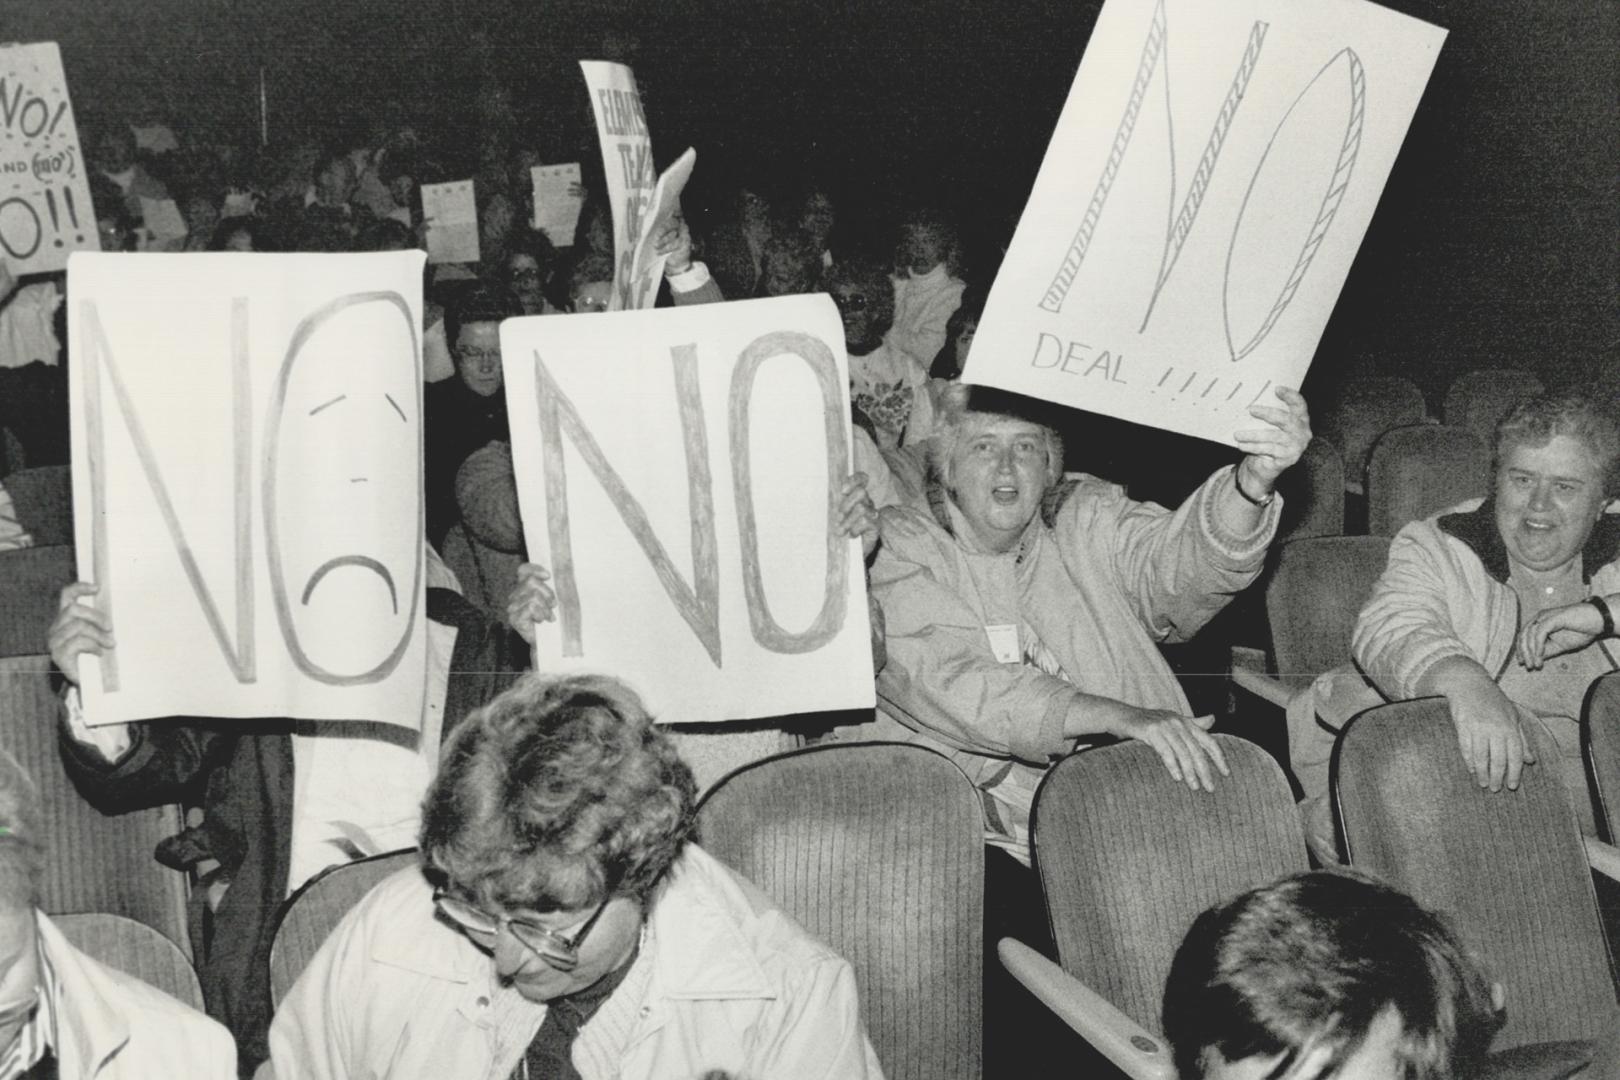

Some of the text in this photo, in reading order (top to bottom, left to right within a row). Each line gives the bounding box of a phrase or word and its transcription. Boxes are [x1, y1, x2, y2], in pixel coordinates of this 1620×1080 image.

[0, 159, 28, 175] ND
[1037, 0, 1367, 362] NO
[79, 289, 425, 694] NO
[533, 329, 851, 670] NO
[1031, 332, 1128, 385] DEAL
